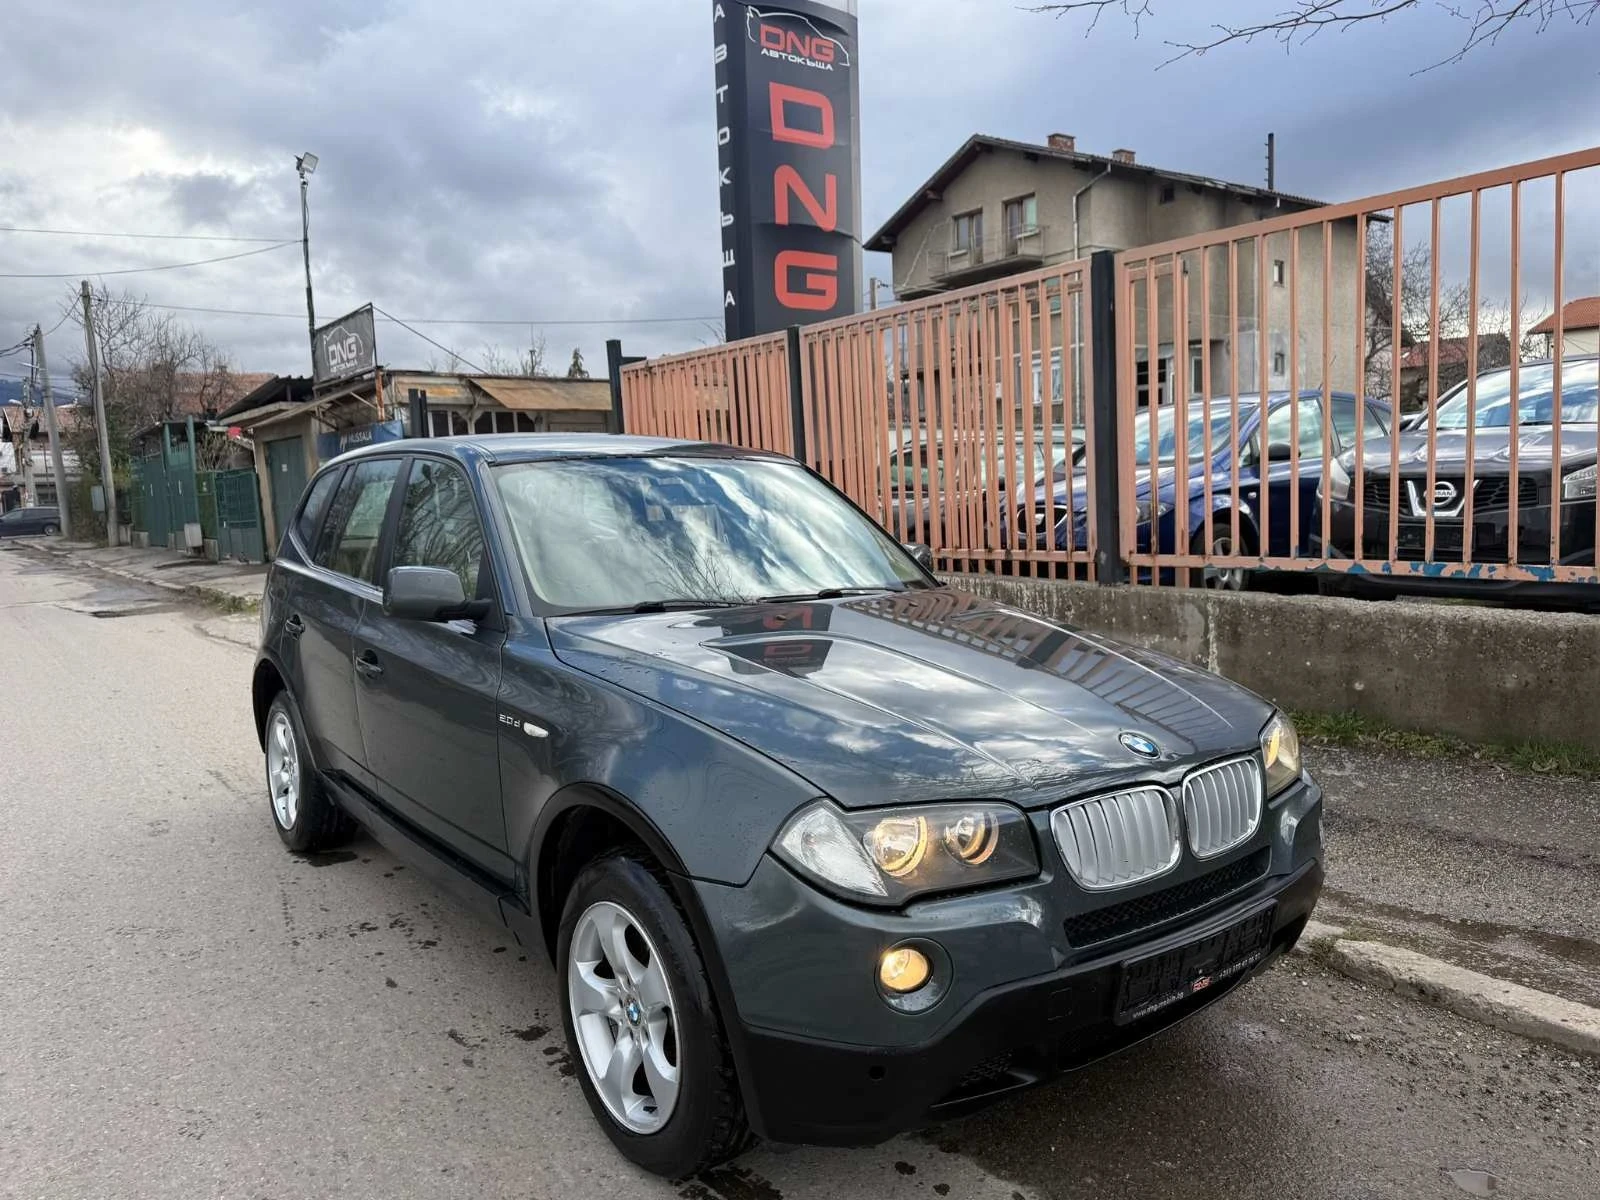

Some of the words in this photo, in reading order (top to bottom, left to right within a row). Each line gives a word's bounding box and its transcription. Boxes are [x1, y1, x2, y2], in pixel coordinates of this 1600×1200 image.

[759, 23, 835, 64] DNG
[768, 81, 838, 311] DNG
[328, 336, 357, 365] DNG
